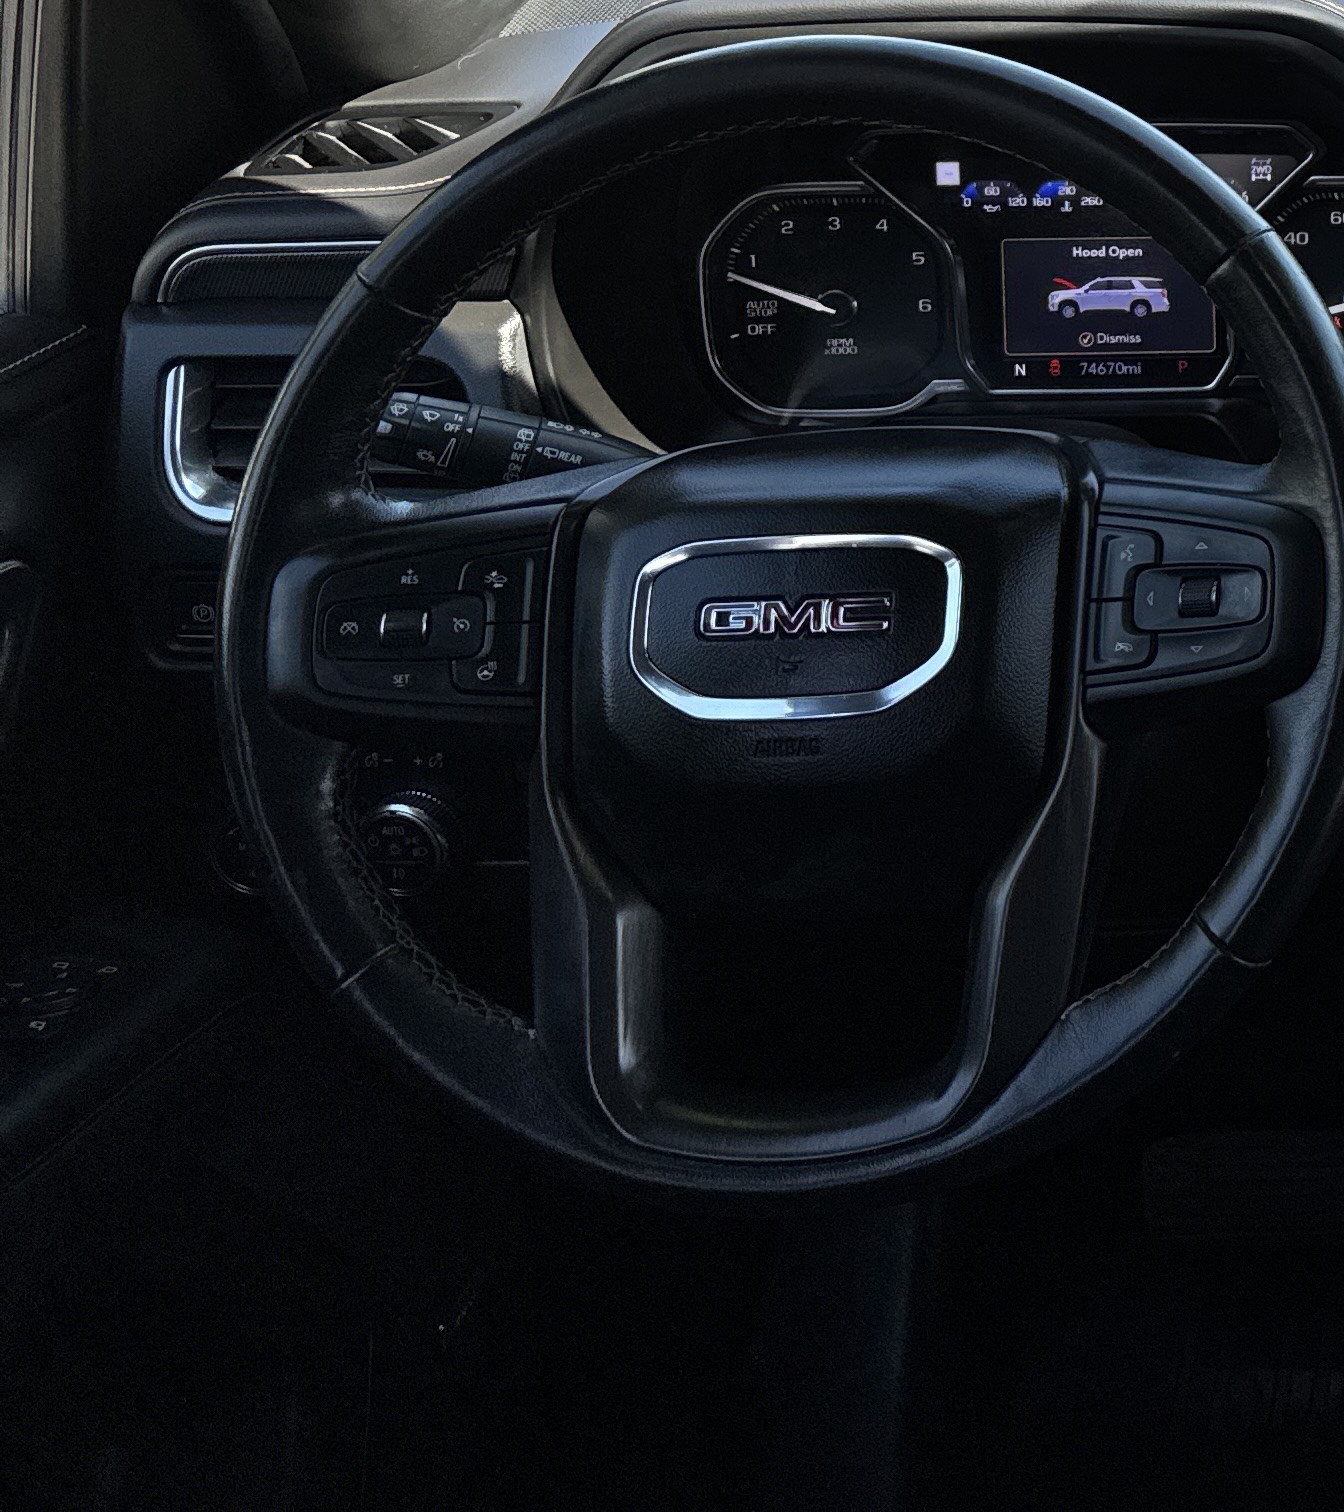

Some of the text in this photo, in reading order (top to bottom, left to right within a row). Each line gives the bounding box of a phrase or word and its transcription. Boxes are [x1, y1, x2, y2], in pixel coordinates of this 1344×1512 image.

[984, 187, 1001, 196] 60
[1058, 186, 1076, 196] 210
[962, 197, 972, 207] 0
[1008, 197, 1028, 207] 120
[1032, 197, 1052, 207] 160
[1080, 197, 1103, 206] 260
[781, 220, 795, 235] 2
[828, 217, 842, 230] 3
[875, 218, 889, 232] 4
[1284, 232, 1309, 245] 40
[911, 251, 926, 266] 5
[1072, 246, 1143, 260] Hood Open
[749, 254, 757, 268] 1
[747, 301, 778, 309] AUTO
[918, 299, 932, 313] 6
[747, 309, 778, 318] STOP
[747, 324, 777, 336] OFF
[826, 338, 854, 346] RPM
[1096, 333, 1142, 344] Dismiss
[1014, 364, 1027, 377] N
[1078, 362, 1142, 376] 74670mi
[1177, 360, 1189, 374] P
[443, 422, 461, 434] OFF
[513, 441, 531, 453] OFF
[510, 452, 528, 464] INT
[558, 451, 583, 466] REAR
[400, 574, 419, 585] RES
[700, 598, 890, 637] GMC
[392, 674, 410, 684] SET
[382, 826, 405, 836] AUTO
